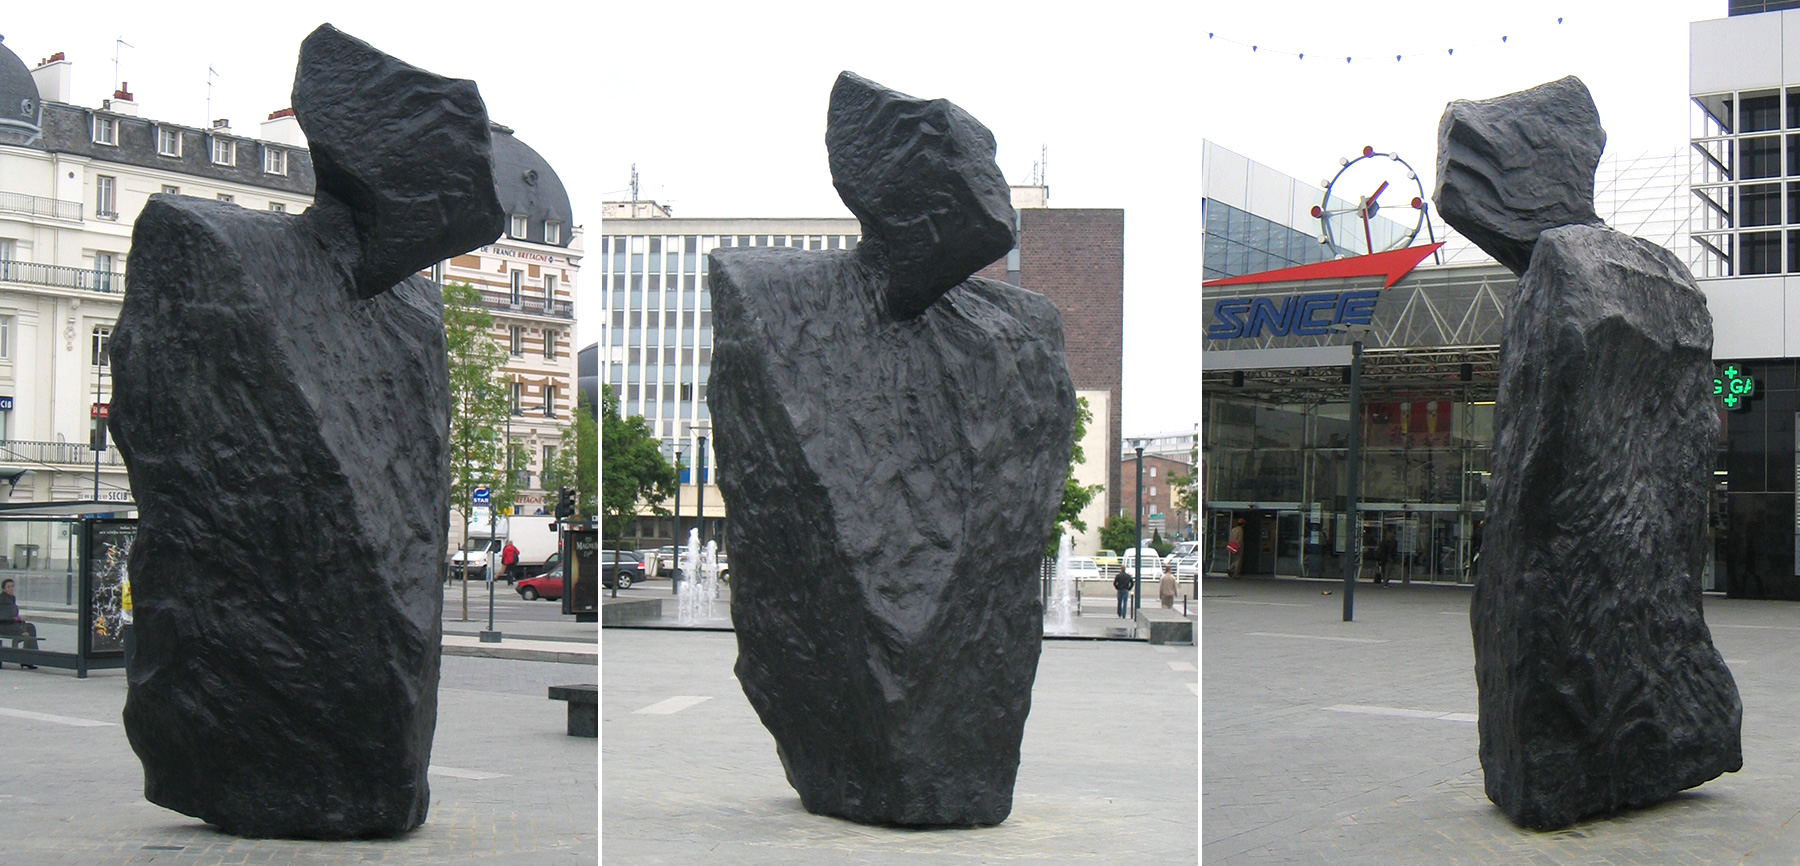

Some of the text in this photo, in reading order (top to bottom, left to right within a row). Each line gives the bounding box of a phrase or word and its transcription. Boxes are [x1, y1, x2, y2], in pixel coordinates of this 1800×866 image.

[493, 248, 516, 257] FRANCE
[517, 252, 547, 262] BRETAGNE
[1207, 290, 1379, 340] SNCF
[0, 400, 12, 409] CIB
[108, 491, 128, 501] SECIB
